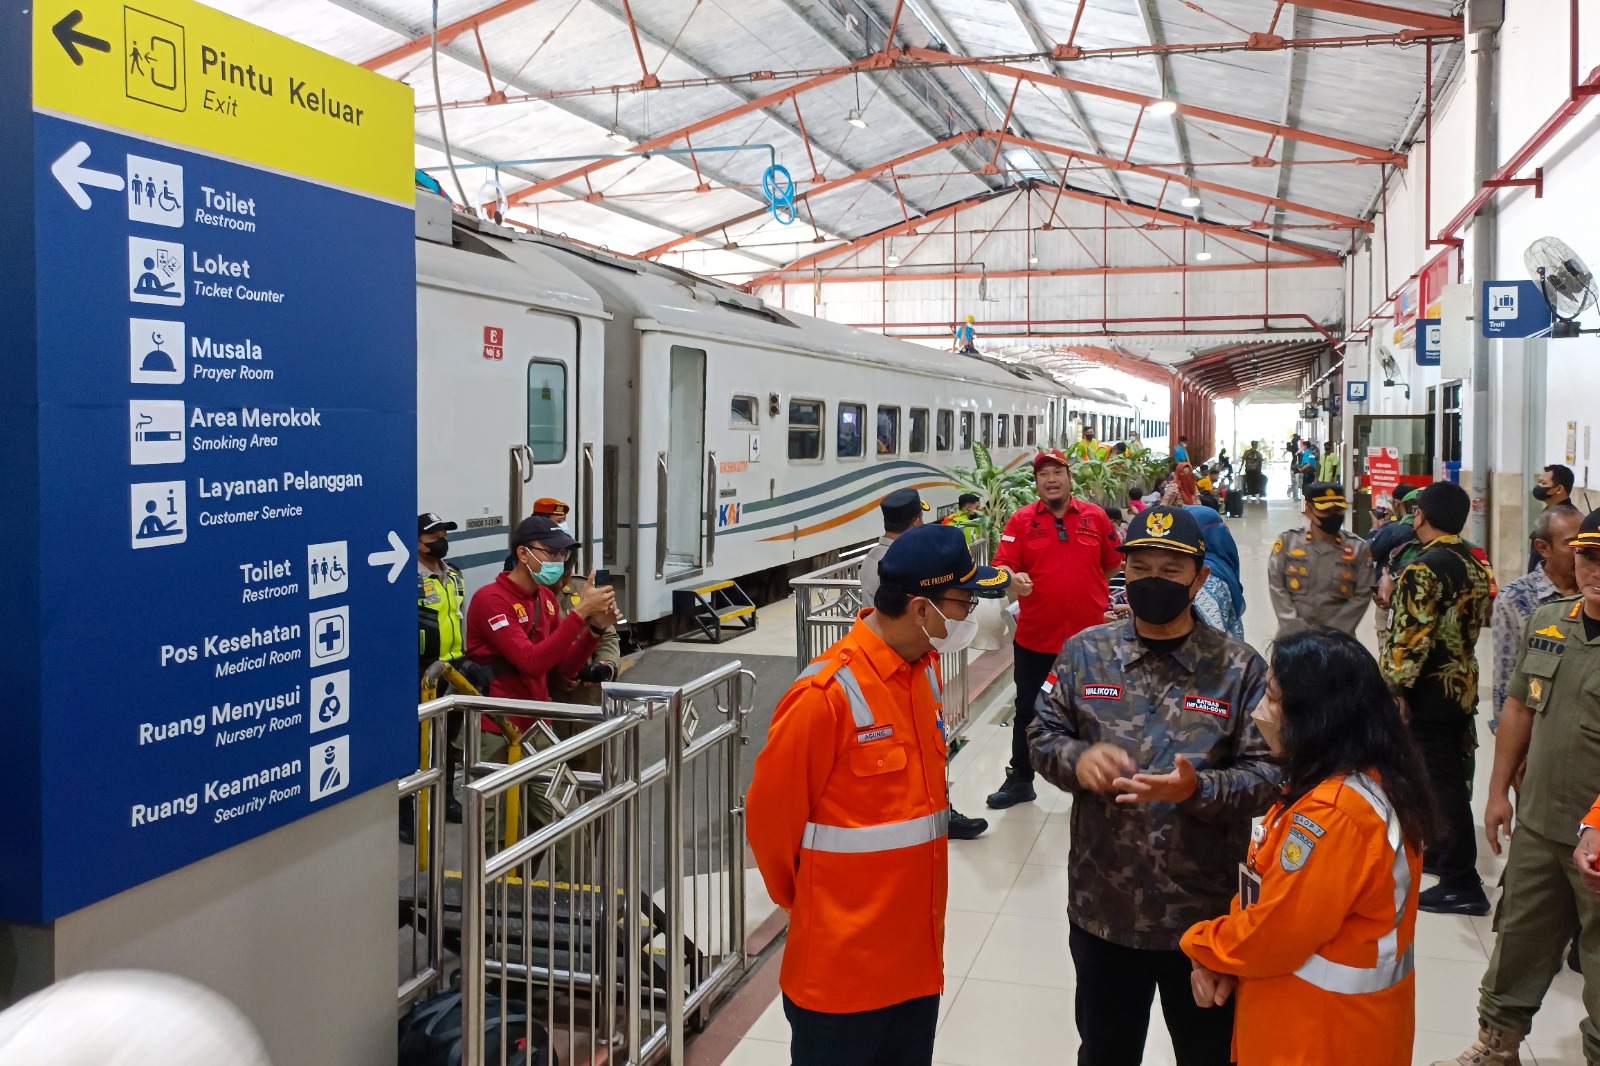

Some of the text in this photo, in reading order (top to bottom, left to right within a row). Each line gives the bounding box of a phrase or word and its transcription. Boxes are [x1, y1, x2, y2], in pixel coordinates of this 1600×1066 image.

[201, 45, 364, 126] Pintu Keluar
[203, 90, 238, 117] Exit
[200, 186, 256, 217] Toilet
[195, 209, 256, 233] Restroom
[193, 252, 250, 279] Loket
[194, 281, 285, 303] Ticket Counter
[192, 337, 263, 360] Musala
[194, 364, 274, 382] Prayer Room
[191, 407, 321, 428] Area Merokok
[193, 434, 278, 452] Smoking Area
[752, 438, 759, 454] 4
[200, 471, 363, 501] Layanan Pelanggan
[200, 505, 303, 527] Customer Service
[240, 560, 291, 584] Toilet
[919, 578, 931, 587] VICE
[243, 584, 299, 604] Restroom
[162, 625, 301, 667] Pos Kesehatan
[216, 649, 301, 678] Medical Room
[1085, 688, 1119, 697] WALIKOTA
[140, 685, 301, 746] Ruang Menyusui
[216, 713, 302, 748] Nursery Room
[864, 731, 886, 741] AGUNG
[132, 760, 302, 828] Ruang Keamanan
[215, 784, 301, 824] Security Room
